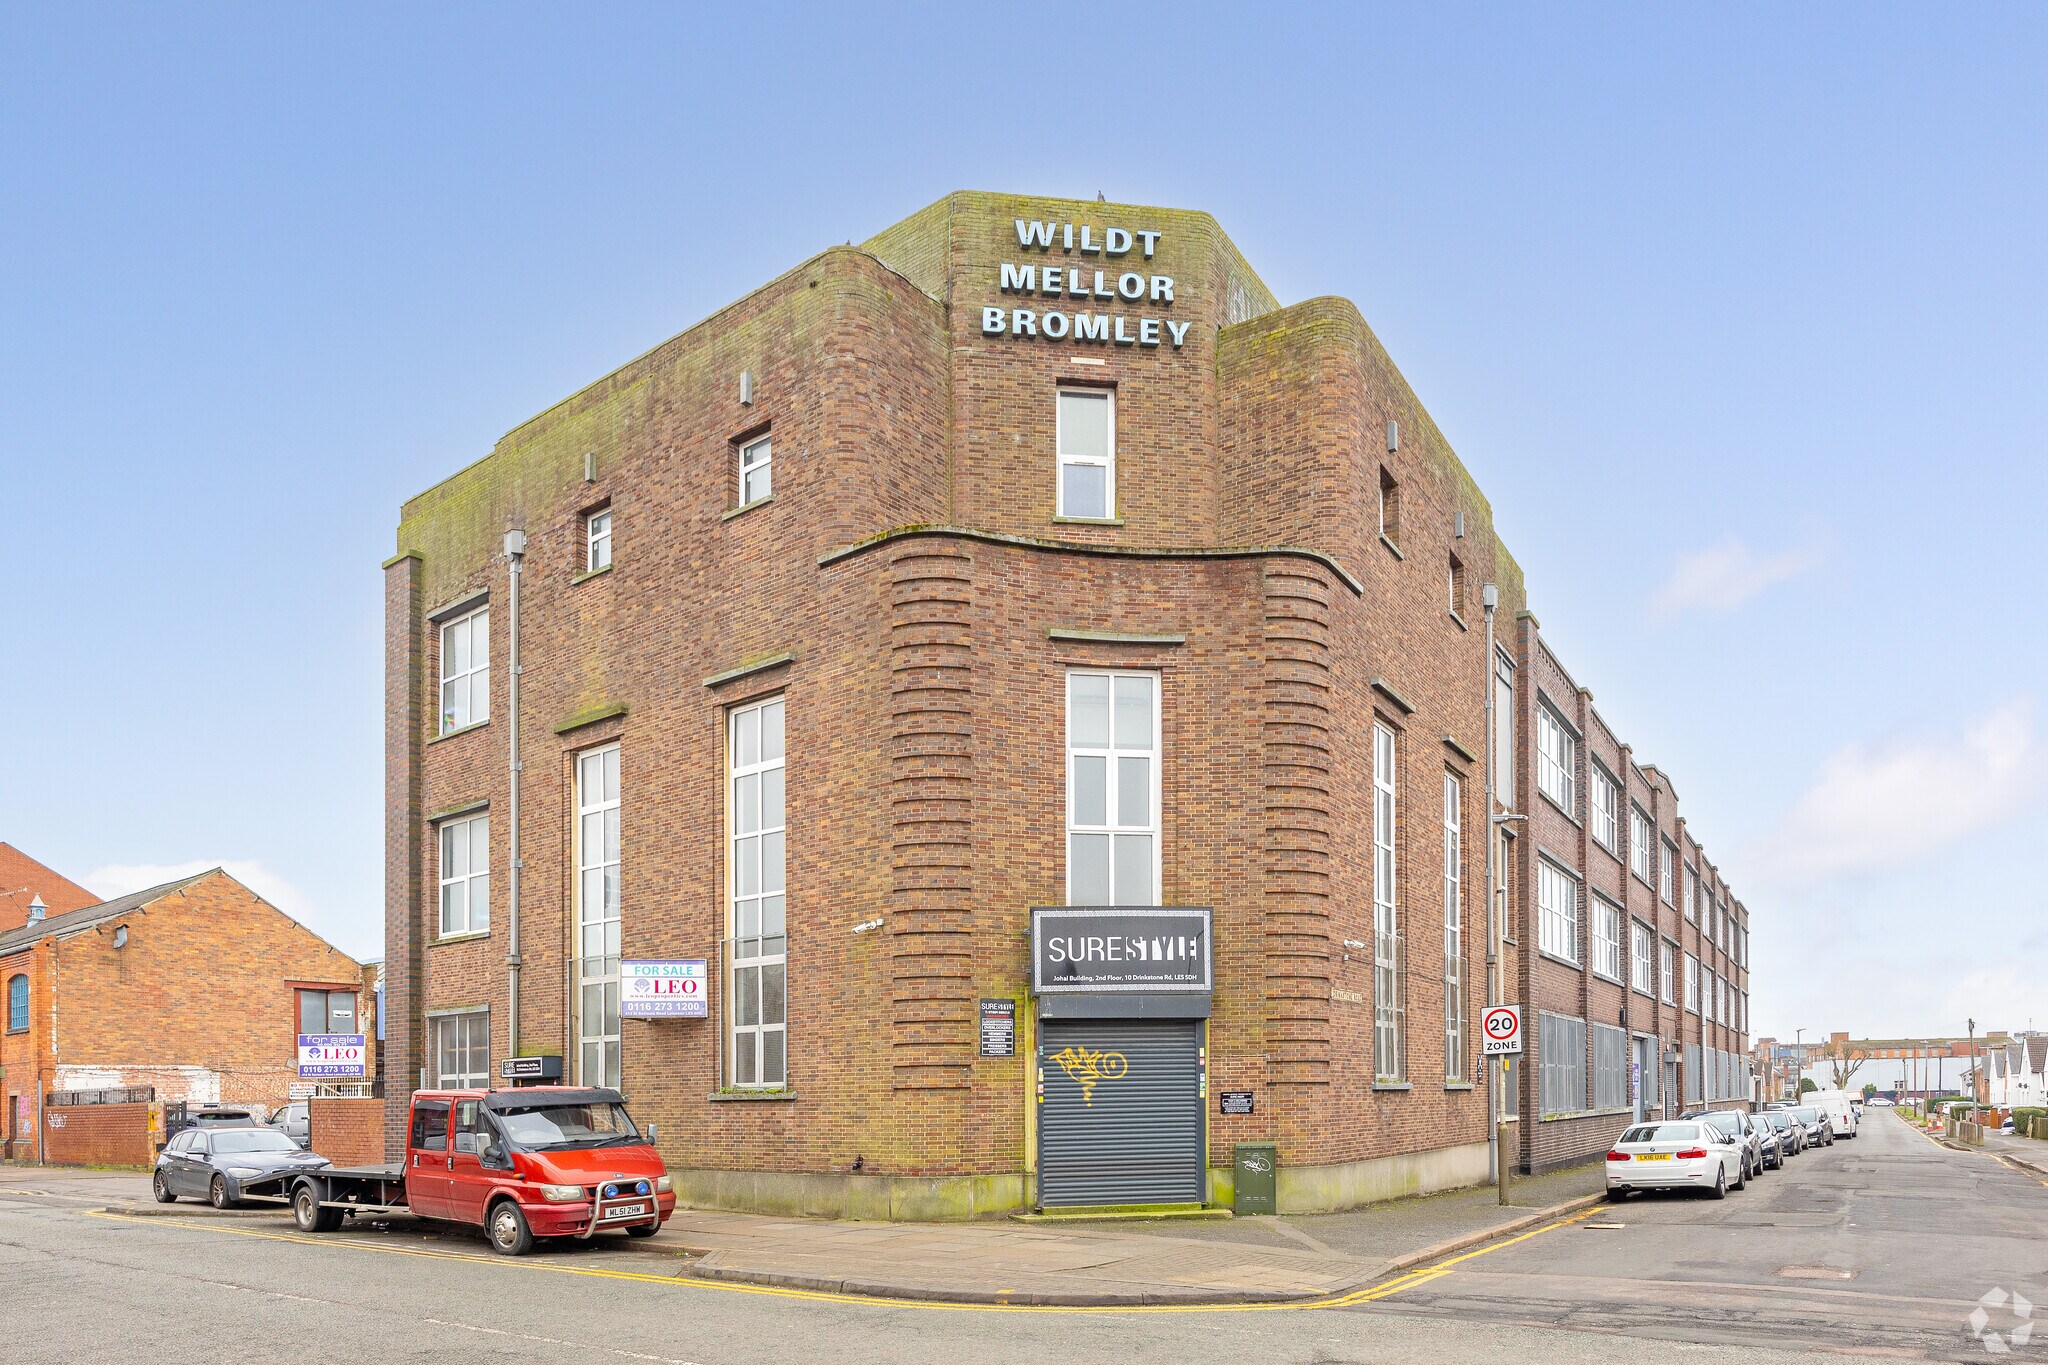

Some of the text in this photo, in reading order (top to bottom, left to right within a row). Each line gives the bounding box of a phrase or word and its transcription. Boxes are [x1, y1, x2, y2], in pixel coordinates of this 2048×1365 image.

[1014, 219, 1162, 259] WILDT
[1000, 263, 1175, 306] MELLOR
[982, 306, 1192, 349] BROMLEY
[634, 966, 693, 975] FOR SALE
[1107, 974, 1124, 982] Floor,
[654, 979, 697, 994] LEO
[627, 1002, 699, 1011] 0116 273 1200
[1489, 1017, 1513, 1031] 20
[307, 1035, 358, 1043] for sale
[1486, 1041, 1517, 1051] ZONE
[324, 1048, 358, 1059] LEO
[609, 1206, 641, 1217] ML51 ZHW
